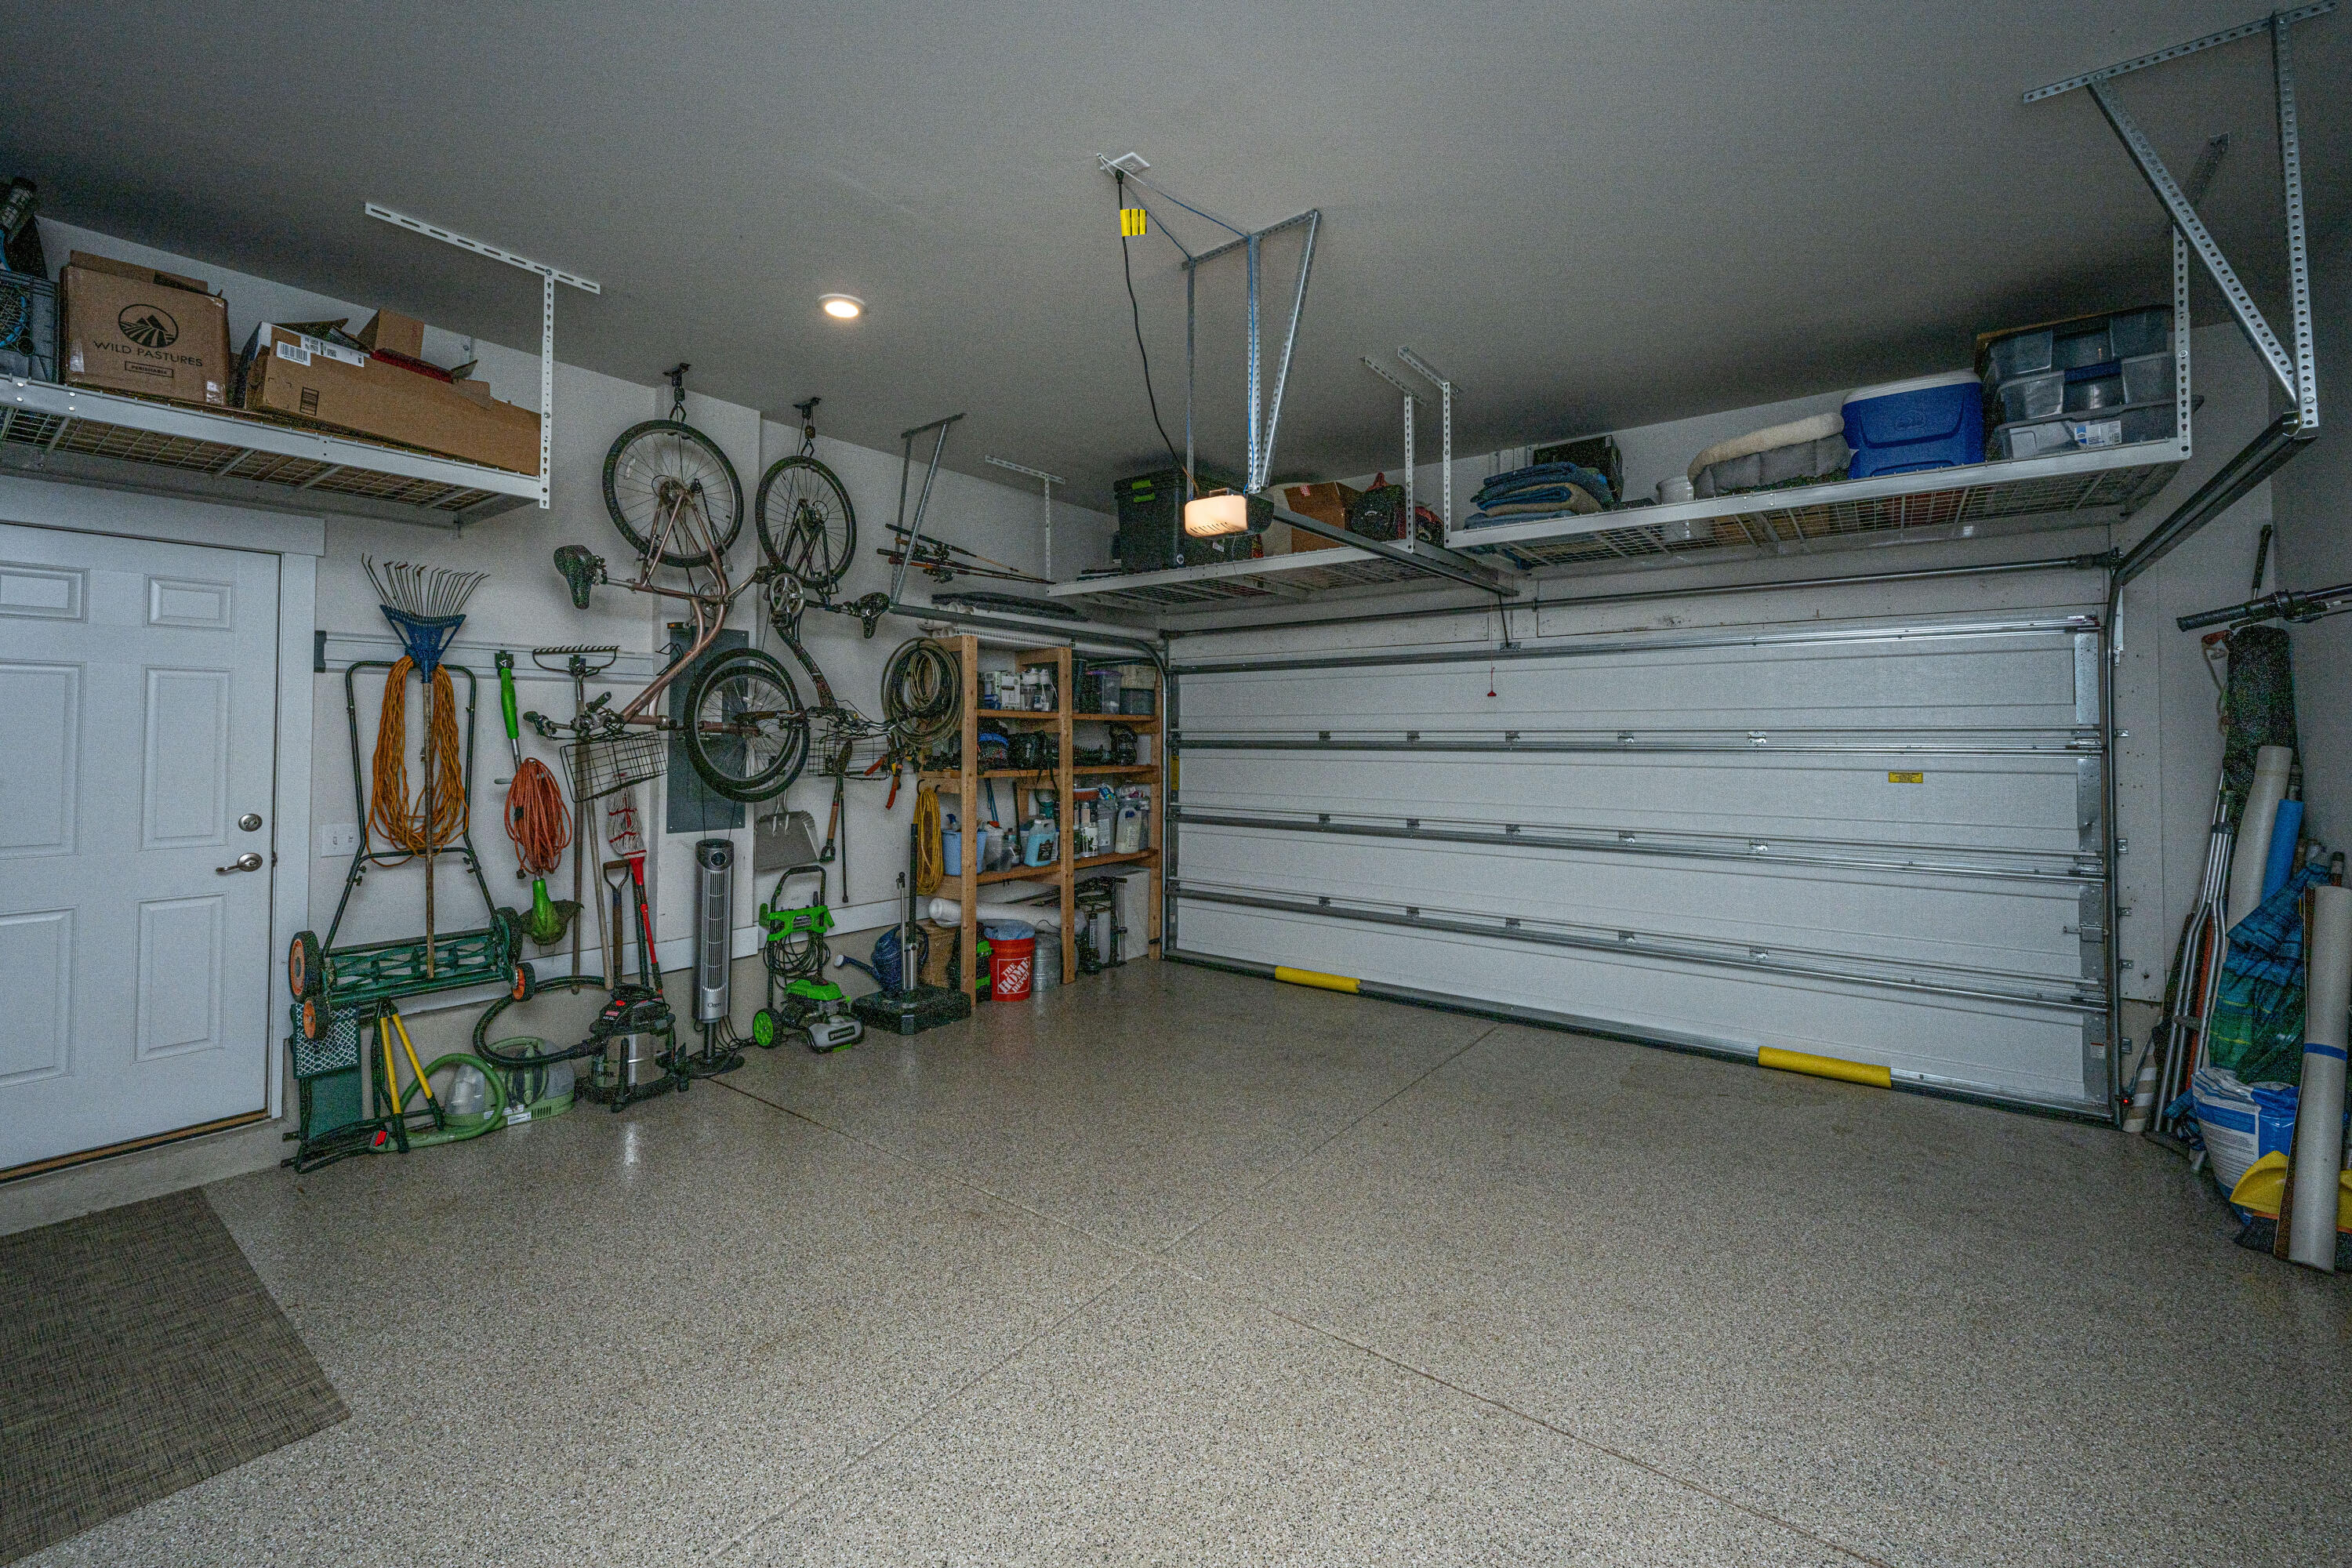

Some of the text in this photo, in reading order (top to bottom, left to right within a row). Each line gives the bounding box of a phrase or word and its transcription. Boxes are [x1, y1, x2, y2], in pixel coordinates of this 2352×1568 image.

[94, 340, 203, 367] WILD PASTURES
[999, 958, 1029, 993] HOME
[1001, 963, 1017, 977] THE
[1011, 970, 1029, 993] DEPOT
